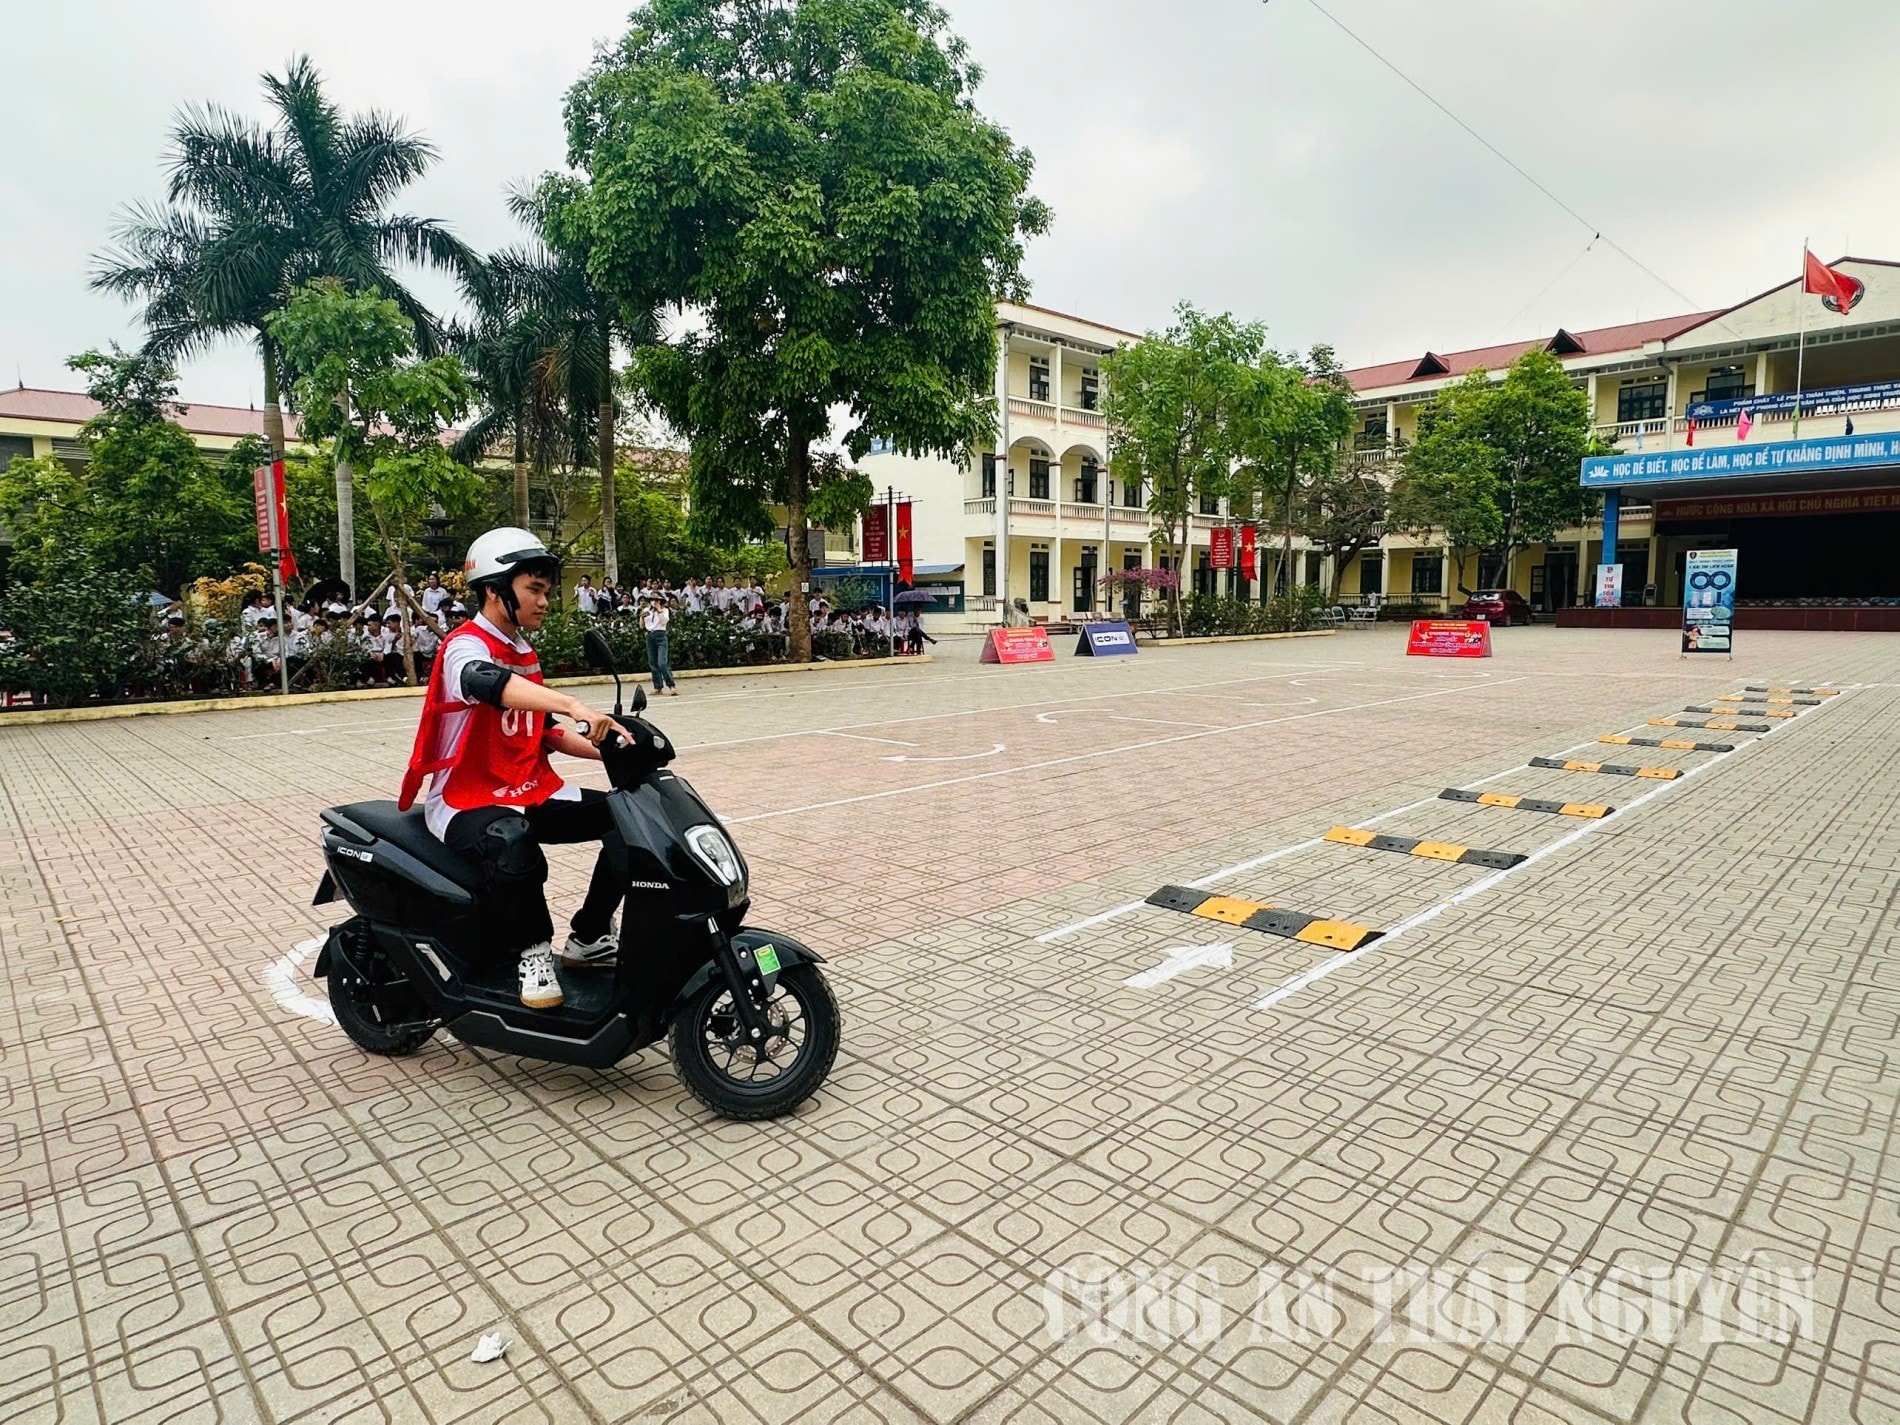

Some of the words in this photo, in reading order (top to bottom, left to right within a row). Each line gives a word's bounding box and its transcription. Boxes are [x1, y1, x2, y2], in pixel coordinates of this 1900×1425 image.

[1613, 464, 1630, 478] HỌC
[1671, 457, 1690, 473] HỌC
[1732, 452, 1752, 469] HỌC
[1854, 440, 1888, 457] MÌNH,
[337, 845, 361, 859] ICON
[631, 880, 671, 890] HONDA
